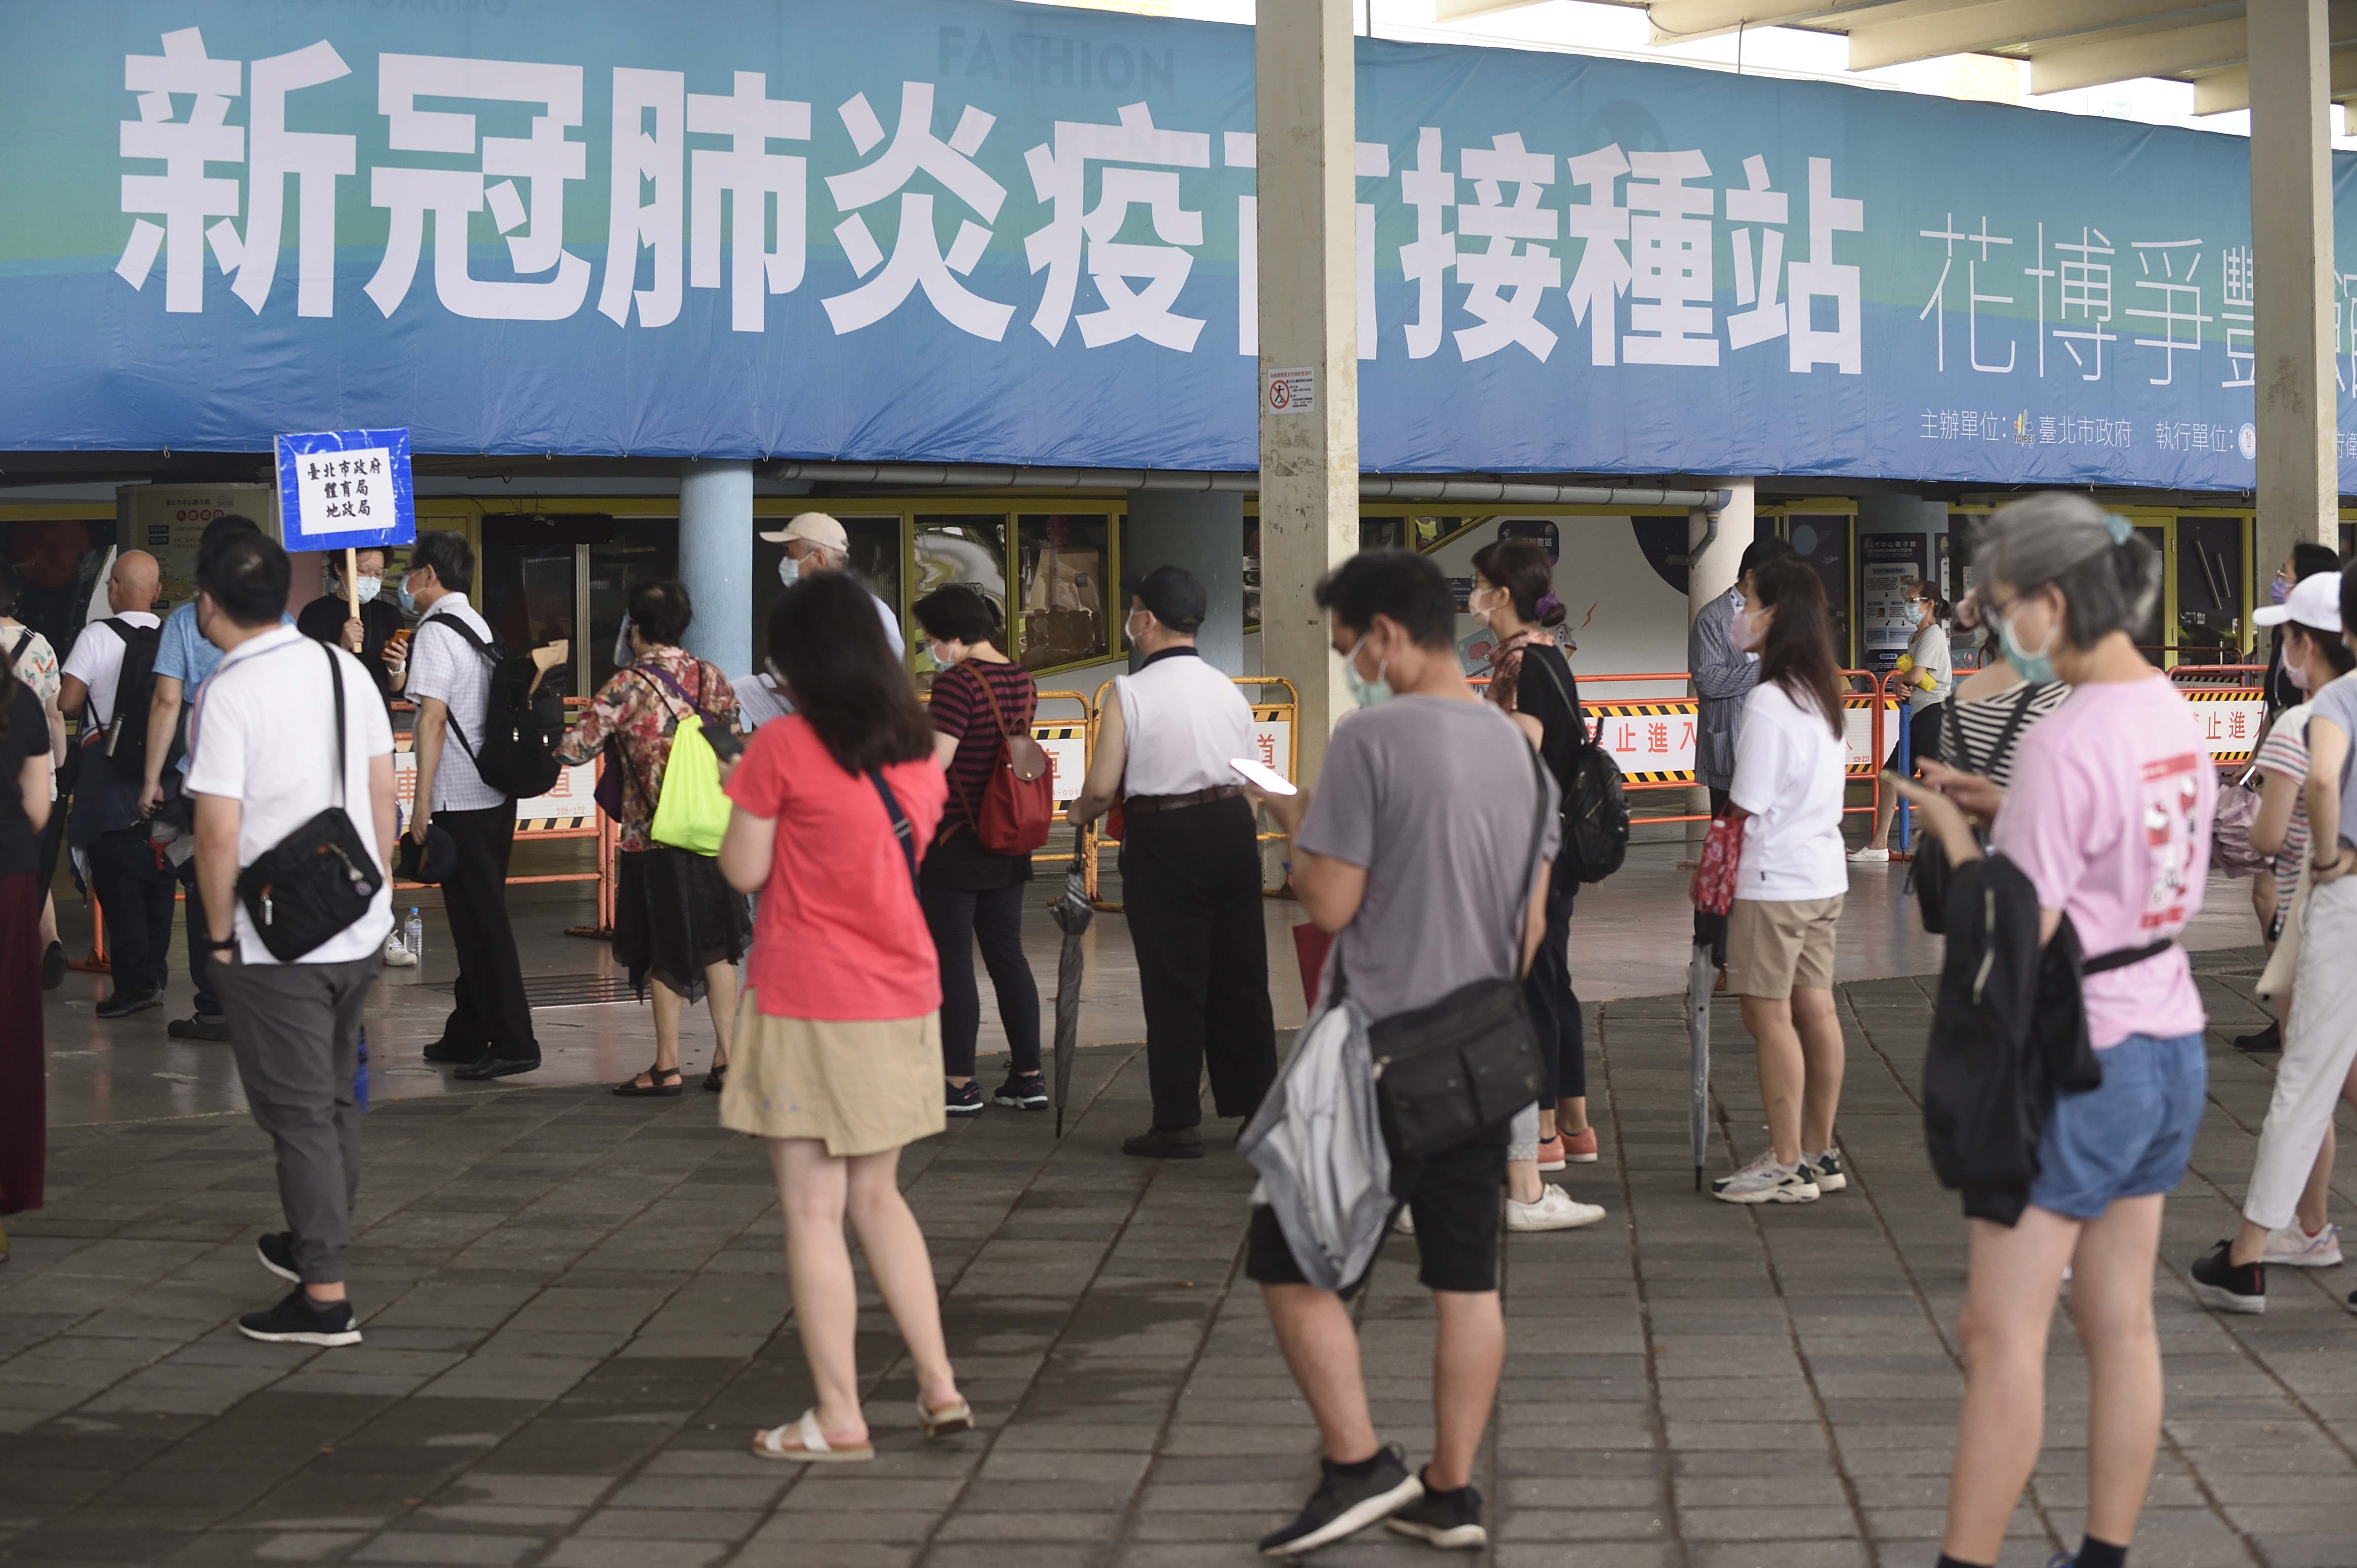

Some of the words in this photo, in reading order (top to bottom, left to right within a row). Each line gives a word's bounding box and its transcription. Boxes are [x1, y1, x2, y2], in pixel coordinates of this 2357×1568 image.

[938, 26, 1174, 96] FASHION
[2013, 434, 2034, 444] TAIPEI
[2039, 415, 2132, 447] 臺北市政府
[308, 457, 381, 480] 臺北市政府
[324, 479, 368, 498] 體育局
[326, 499, 371, 518] 地政局
[557, 806, 586, 815] 106-172
